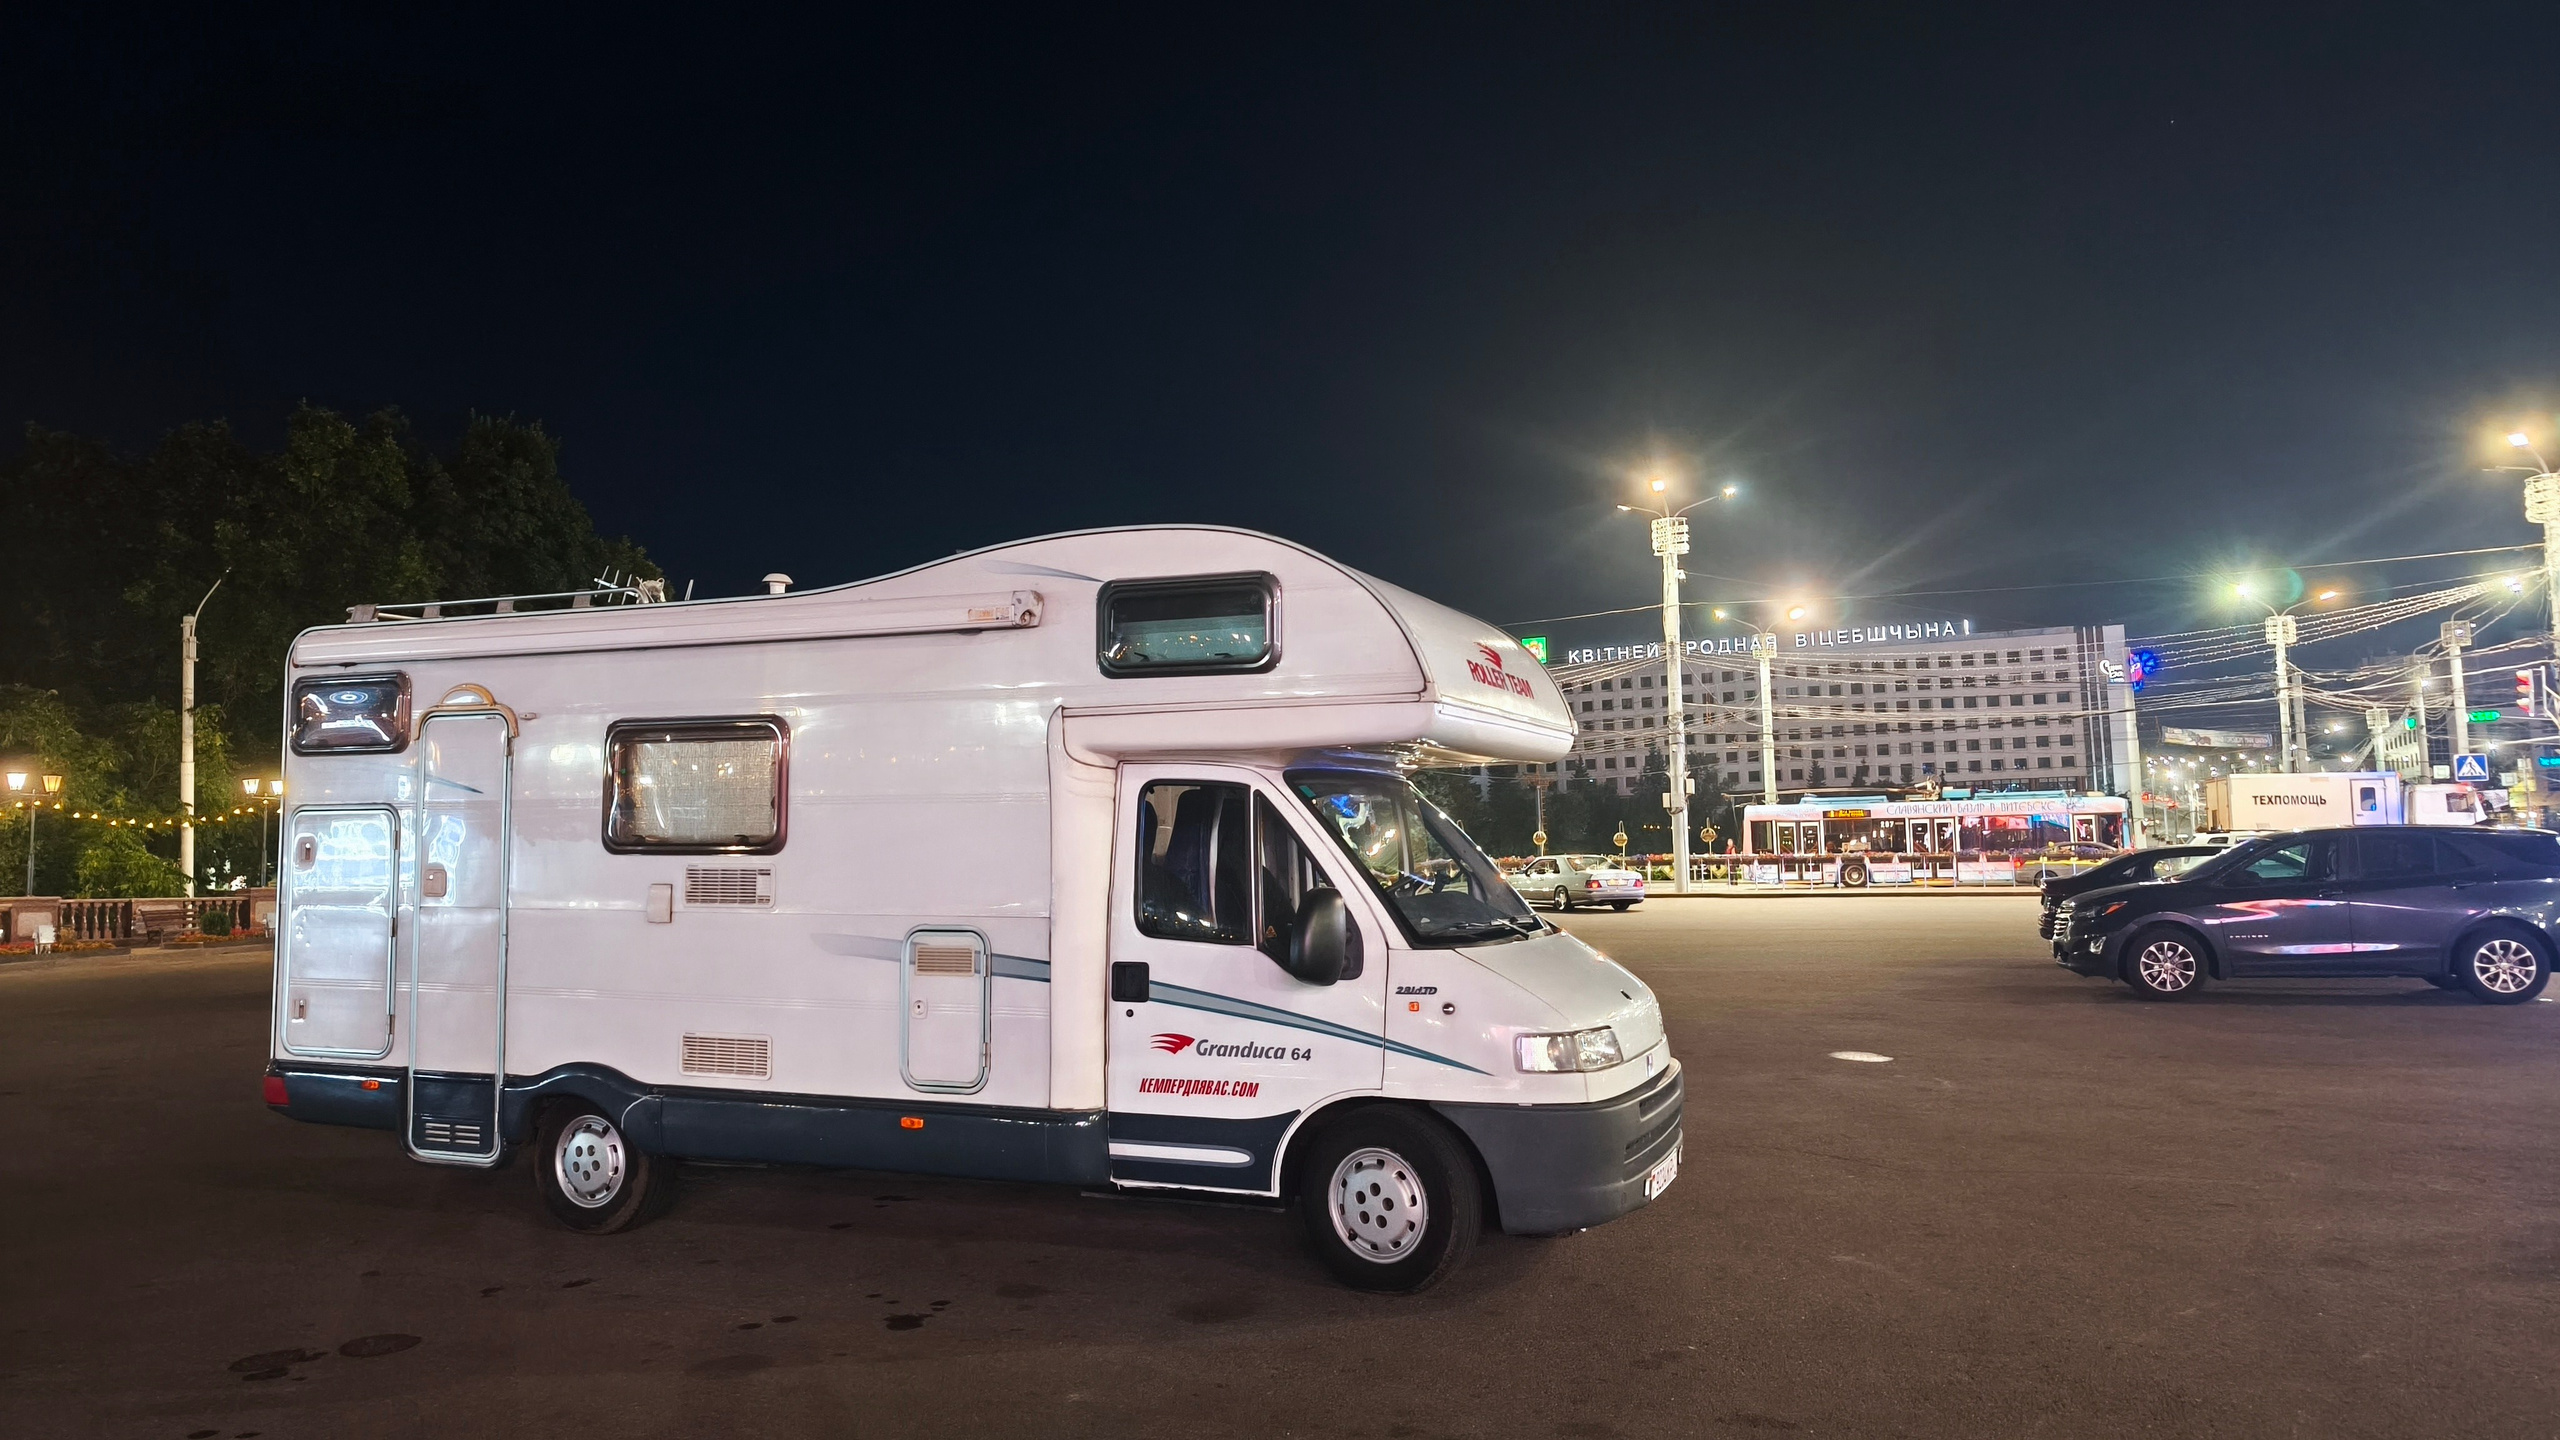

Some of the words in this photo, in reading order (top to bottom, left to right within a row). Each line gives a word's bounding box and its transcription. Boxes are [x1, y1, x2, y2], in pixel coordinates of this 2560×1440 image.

[1568, 642, 1660, 664] КВІТНЕЙ
[1686, 636, 1778, 655] РОДНАЯ
[1466, 659, 1509, 691] ROLLER
[1505, 672, 1535, 699] TEAM
[1886, 802, 1953, 816] СЛАВЯНСКИЙ
[1958, 802, 1985, 814] БАЗАР
[1990, 802, 1996, 812] В
[2001, 801, 2056, 813] ВИТЕБСКЕ
[2252, 795, 2327, 807] ТЕХПОМОЩЬ
[1196, 1039, 1287, 1060] Granduca
[1291, 1047, 1312, 1061] 64
